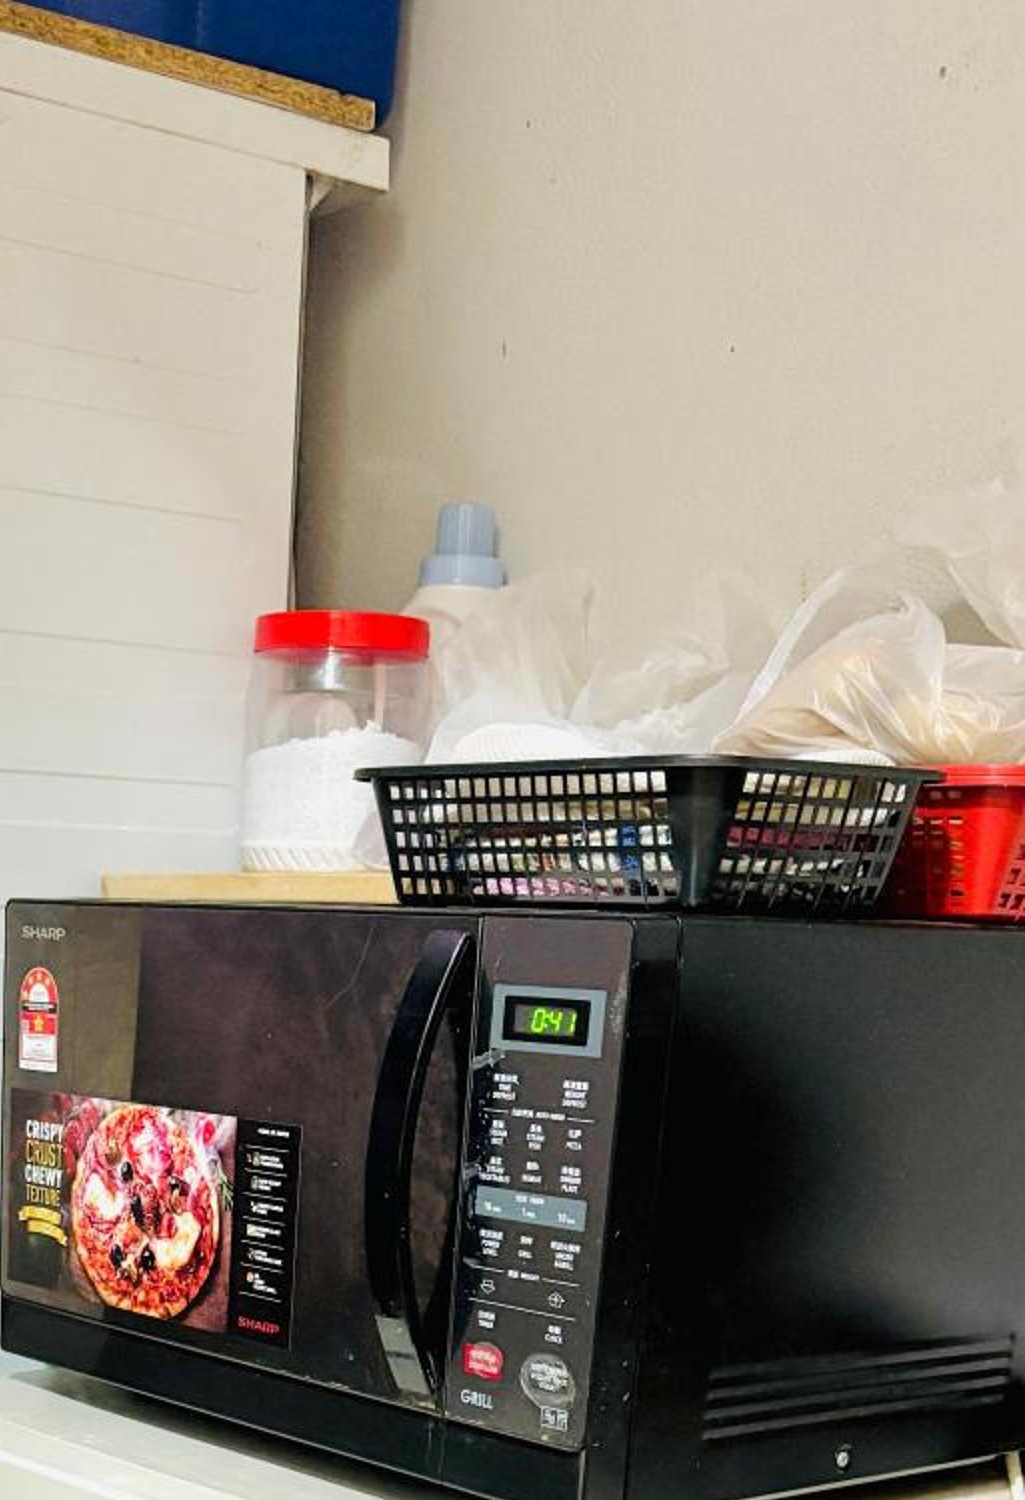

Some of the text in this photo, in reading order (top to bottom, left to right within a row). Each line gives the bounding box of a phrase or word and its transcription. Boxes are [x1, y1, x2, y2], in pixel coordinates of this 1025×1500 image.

[22, 925, 66, 941] SHARP
[530, 1008, 577, 1033] 0:41
[26, 1119, 63, 1143] CRISPY
[26, 1139, 63, 1168] CRUST
[25, 1163, 63, 1188] CHEWY
[238, 1315, 279, 1334] SHARP
[461, 1389, 493, 1409] GRILL
